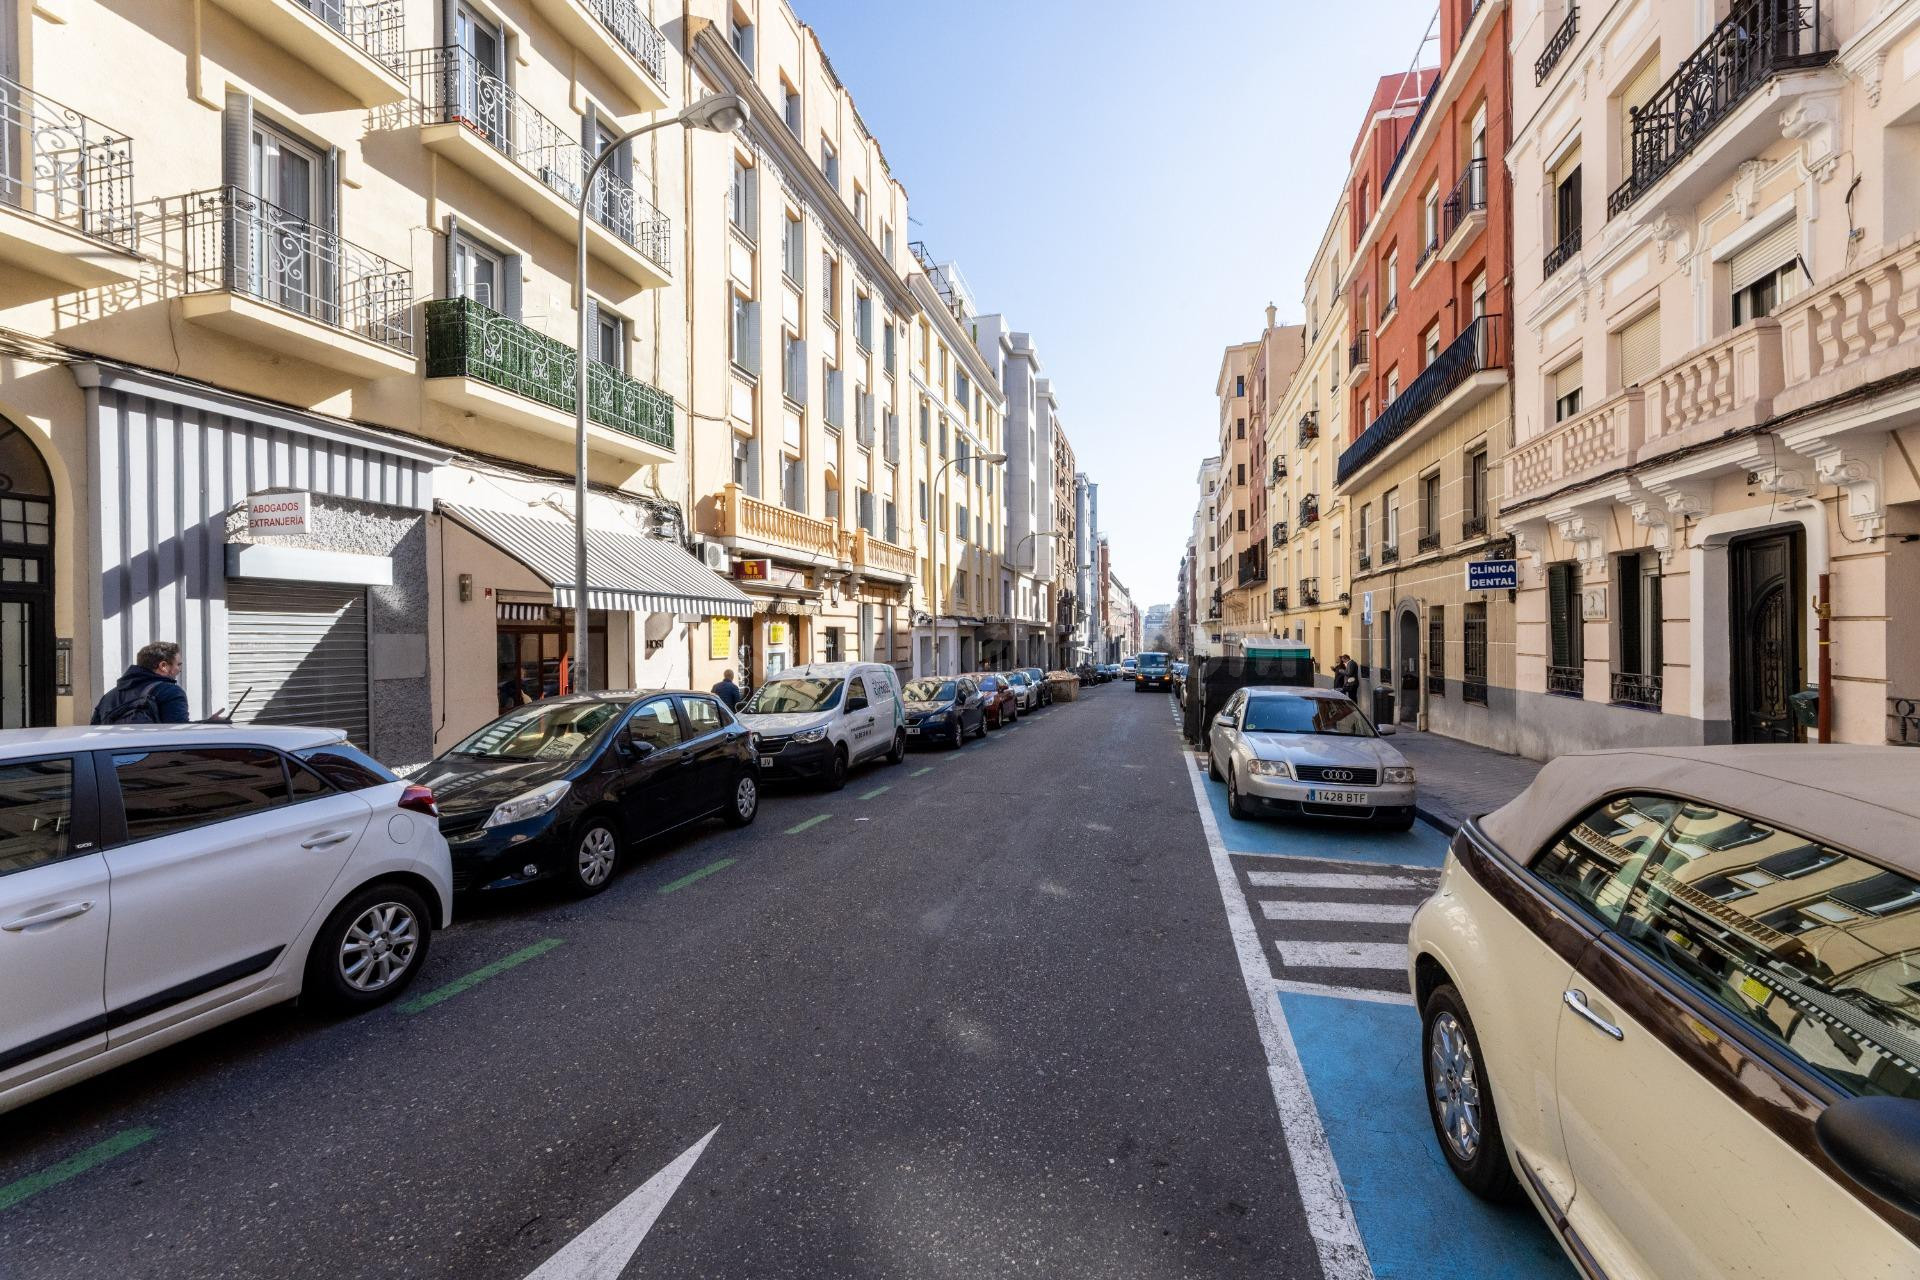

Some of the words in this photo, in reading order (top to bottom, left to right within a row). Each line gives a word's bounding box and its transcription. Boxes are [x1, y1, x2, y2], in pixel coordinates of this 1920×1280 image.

[252, 502, 299, 514] ABOGADOS
[249, 516, 304, 528] EXTRANJERÍA
[1470, 564, 1515, 575] CLÍNICA
[1471, 577, 1515, 587] DENTAL
[1319, 791, 1343, 802] 1428
[1346, 793, 1366, 803] BTF
